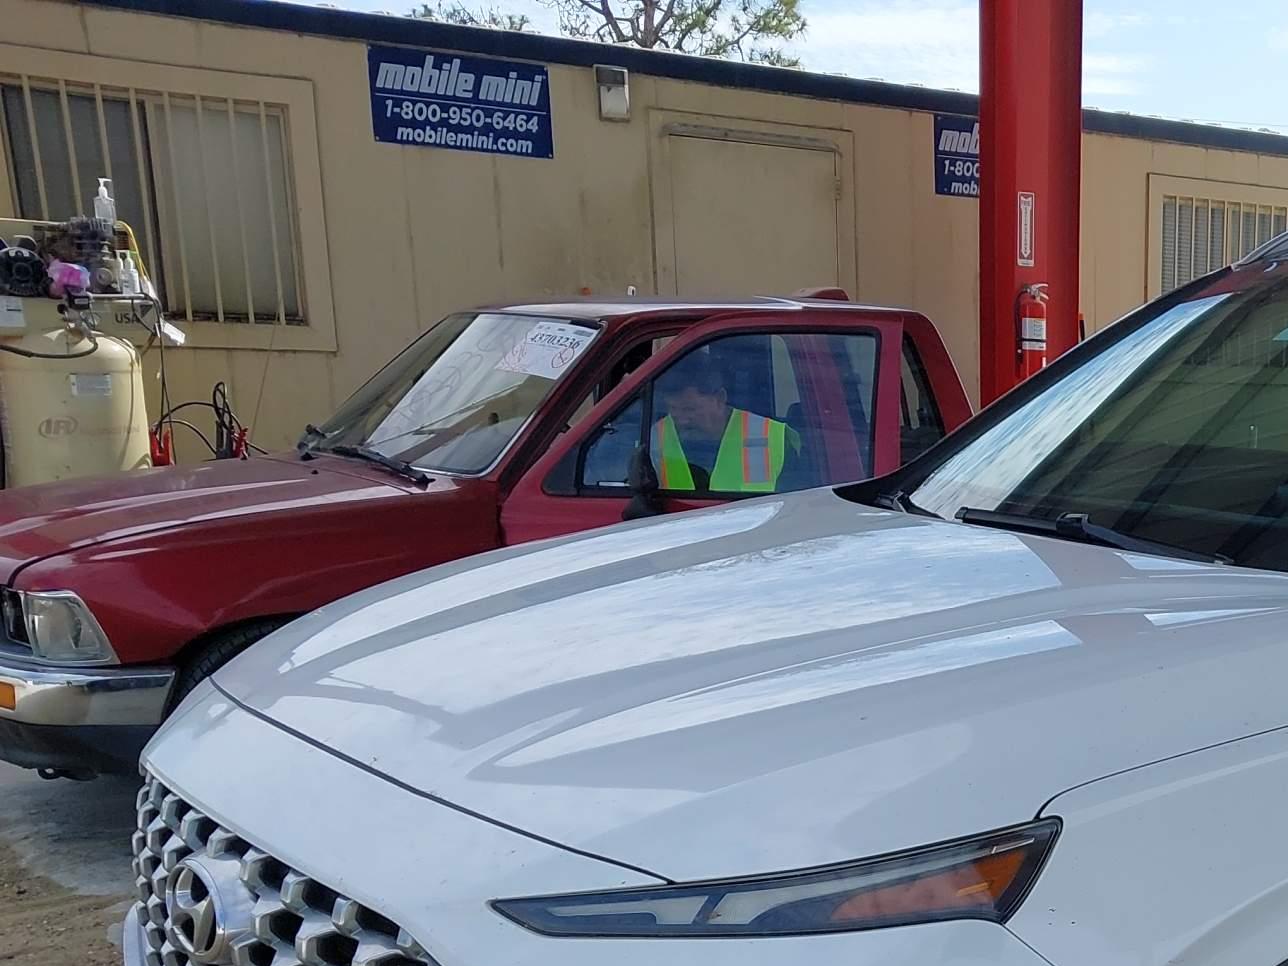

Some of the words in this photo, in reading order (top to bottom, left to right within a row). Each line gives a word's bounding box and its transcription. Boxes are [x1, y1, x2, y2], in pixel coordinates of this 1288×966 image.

[376, 55, 475, 98] mobile
[479, 72, 543, 106] mini
[385, 99, 538, 133] 1-800-950-6464
[396, 126, 532, 153] mobilemini.com
[114, 312, 140, 324] USA
